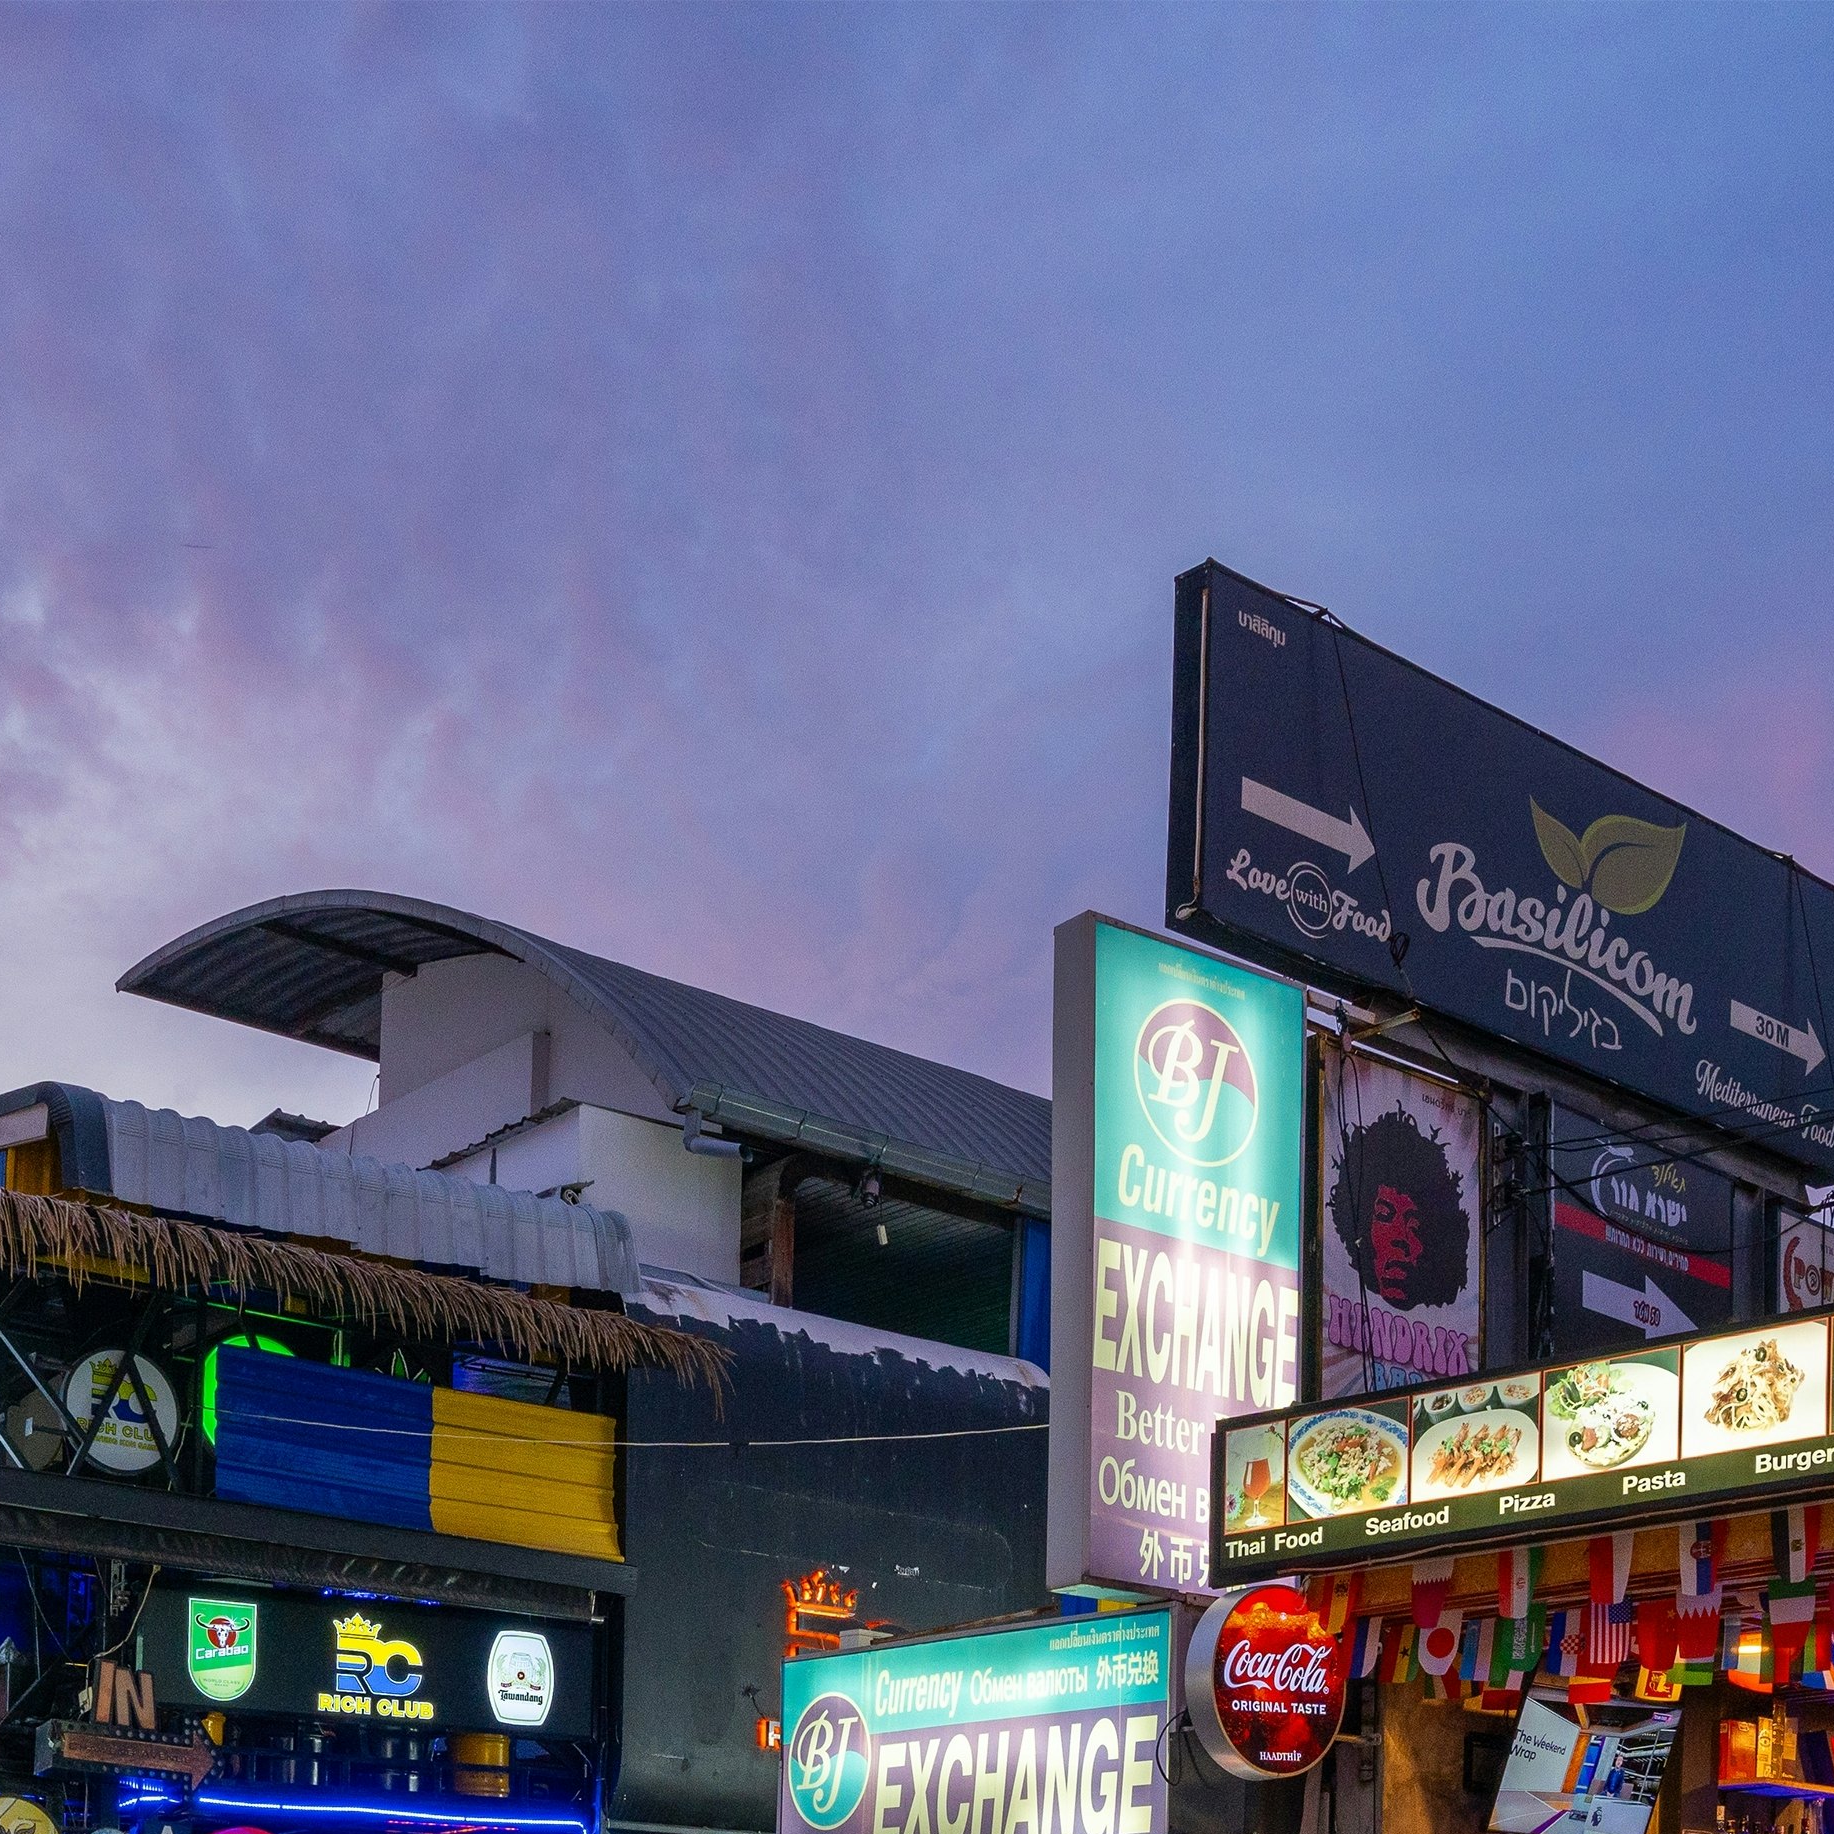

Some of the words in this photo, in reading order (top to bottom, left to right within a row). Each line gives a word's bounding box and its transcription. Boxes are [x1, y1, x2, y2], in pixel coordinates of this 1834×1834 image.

[1226, 846, 1290, 902] Love
[1294, 884, 1331, 916] with
[1331, 889, 1392, 944] Food
[1416, 841, 1697, 1035] Basilicom
[1147, 1018, 1239, 1143] BJ
[1695, 1058, 1797, 1128] Mediterranean
[1118, 1143, 1280, 1258] Currency
[1092, 1239, 1300, 1412] EXCHANGE
[1115, 1389, 1205, 1457] Better
[1098, 1455, 1186, 1520] Обмен
[1499, 1489, 1556, 1515] Pizza
[1622, 1467, 1687, 1497] Pasta
[1225, 1534, 1266, 1559] Thai
[1274, 1526, 1323, 1554] Food
[1365, 1505, 1450, 1537] Seafood
[195, 1643, 250, 1661] Carabao
[335, 1640, 424, 1697] RC
[1223, 1638, 1331, 1695] Coca-Cola
[94, 1660, 156, 1730] IN
[317, 1693, 372, 1714] RICH
[376, 1698, 435, 1720] CLUB
[498, 1688, 544, 1706] Tawandang
[875, 1669, 964, 1718] Currency
[969, 1668, 1023, 1706] Обмен
[1026, 1664, 1089, 1698] валюты
[1095, 1650, 1160, 1691] 外币兑换
[1231, 1699, 1287, 1714] ORIGINAL
[1291, 1703, 1327, 1716] TASTE
[1510, 1744, 1537, 1763] Wrap
[1515, 1728, 1532, 1744] The
[1532, 1731, 1567, 1757] Weekend
